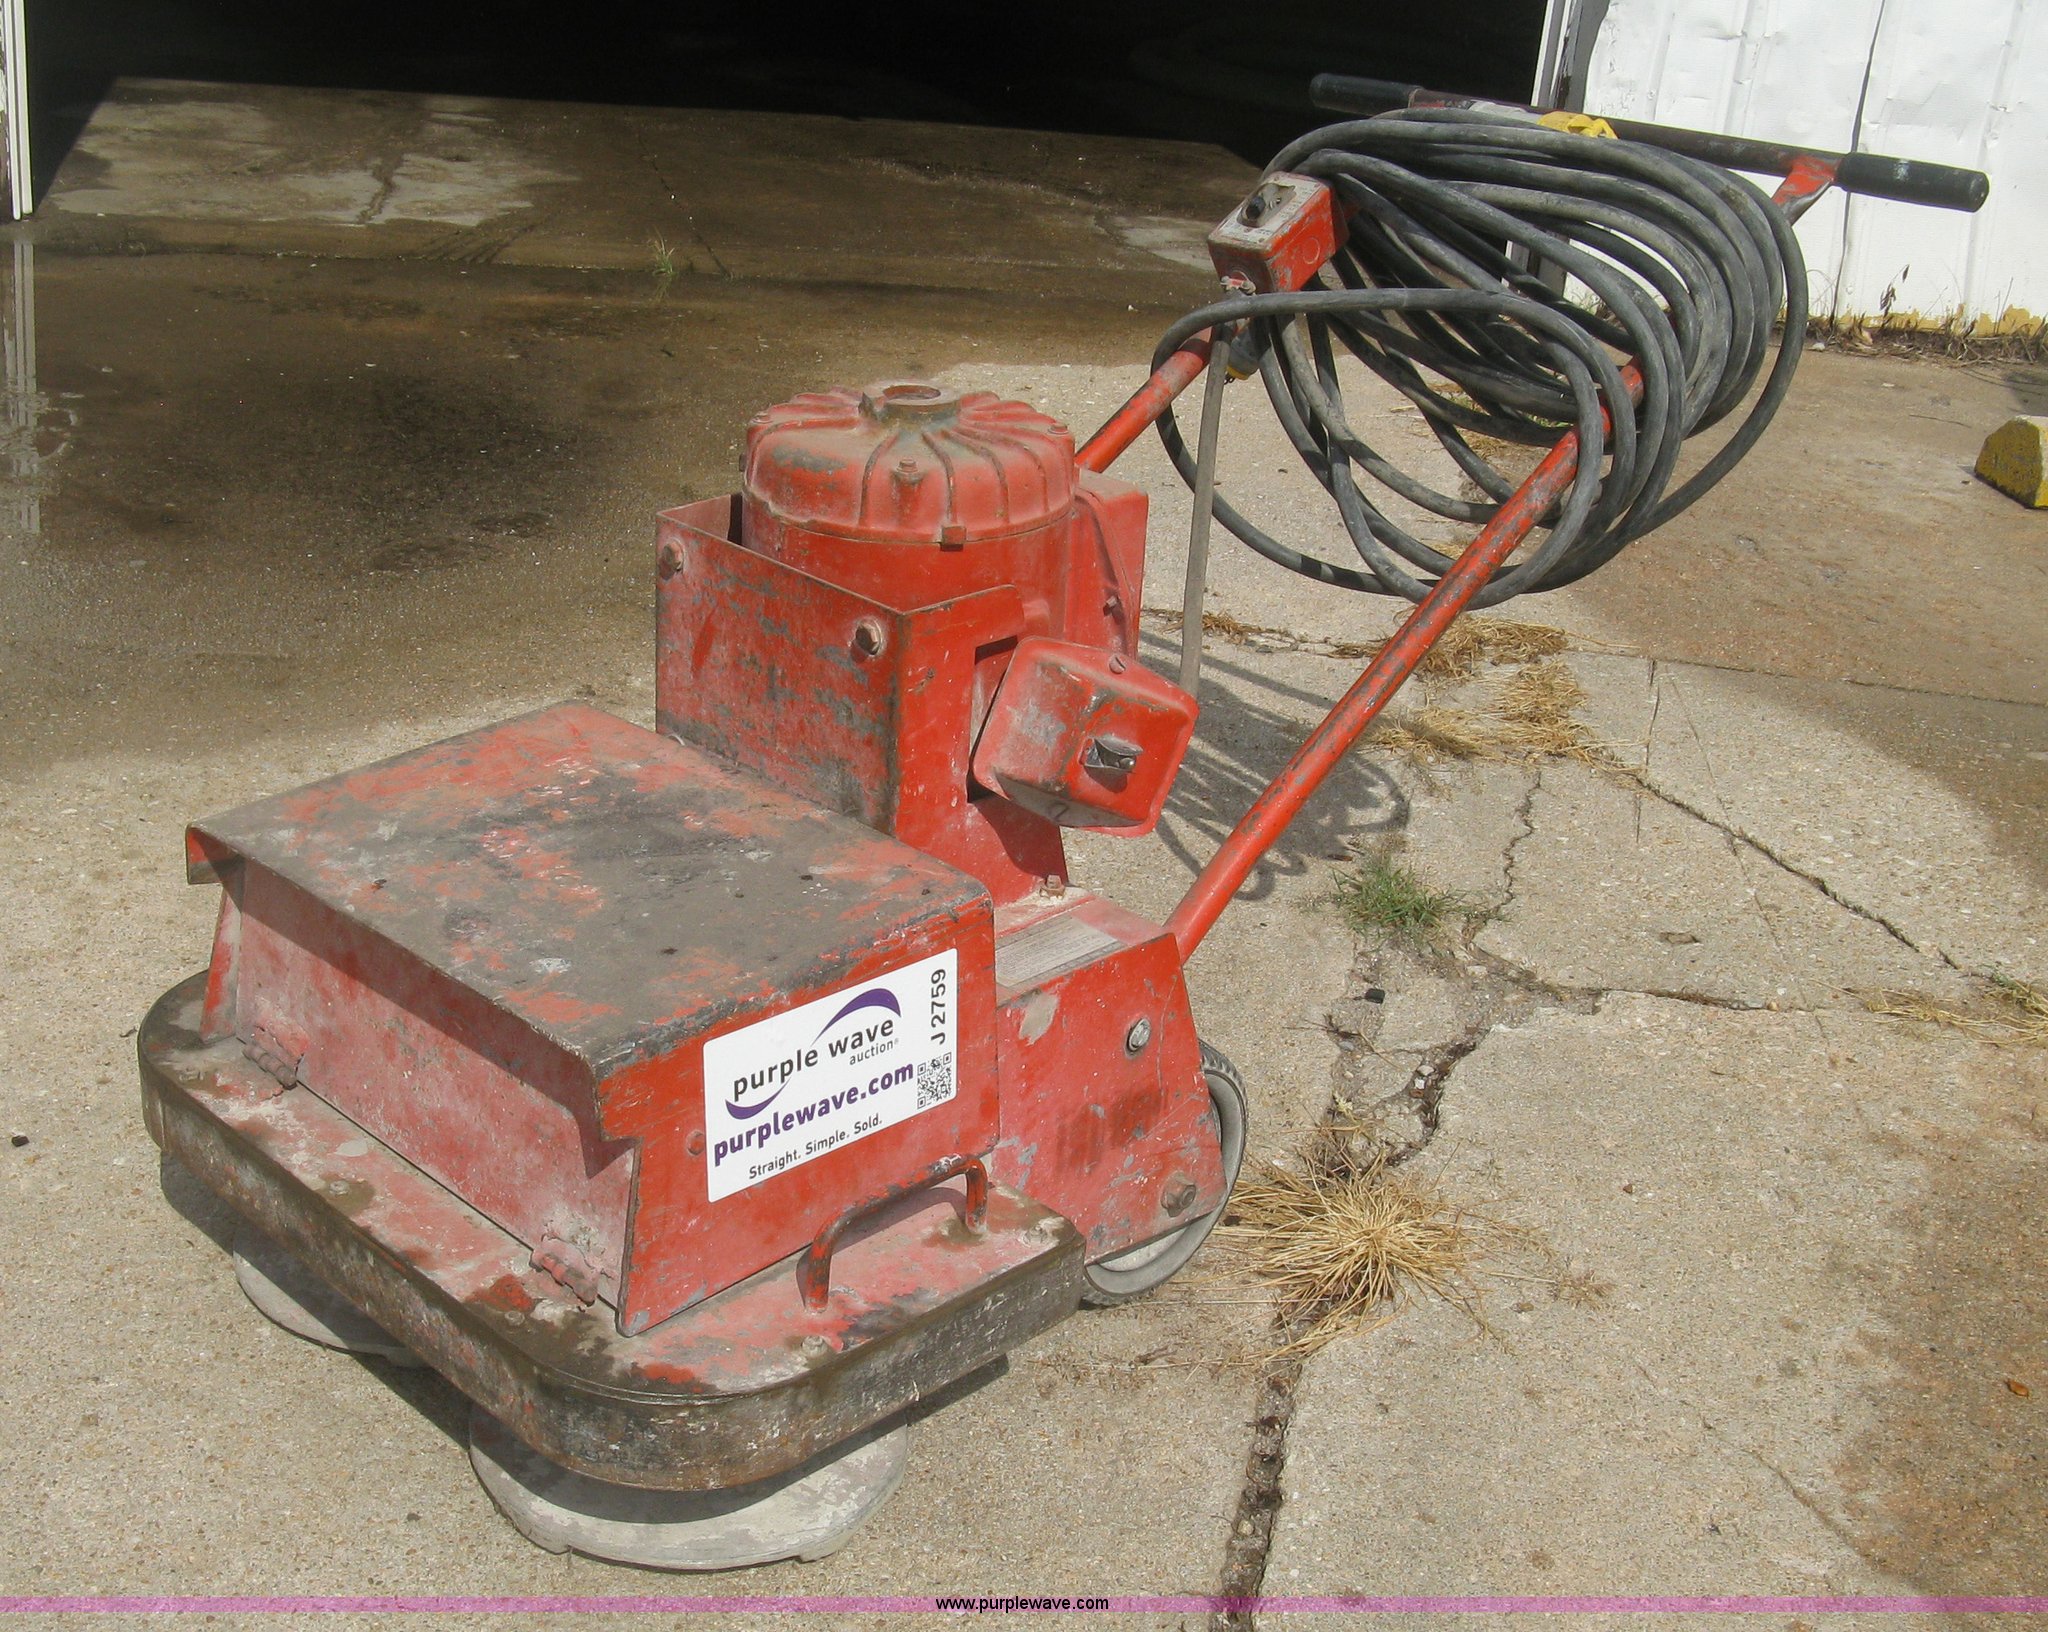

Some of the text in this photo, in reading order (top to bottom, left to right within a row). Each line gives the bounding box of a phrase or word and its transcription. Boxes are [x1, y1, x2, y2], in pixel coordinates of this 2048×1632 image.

[733, 1019, 894, 1103] purple wave
[714, 1063, 914, 1168] purplewave.com
[749, 1113, 883, 1180] Straight. Simple. Sold.
